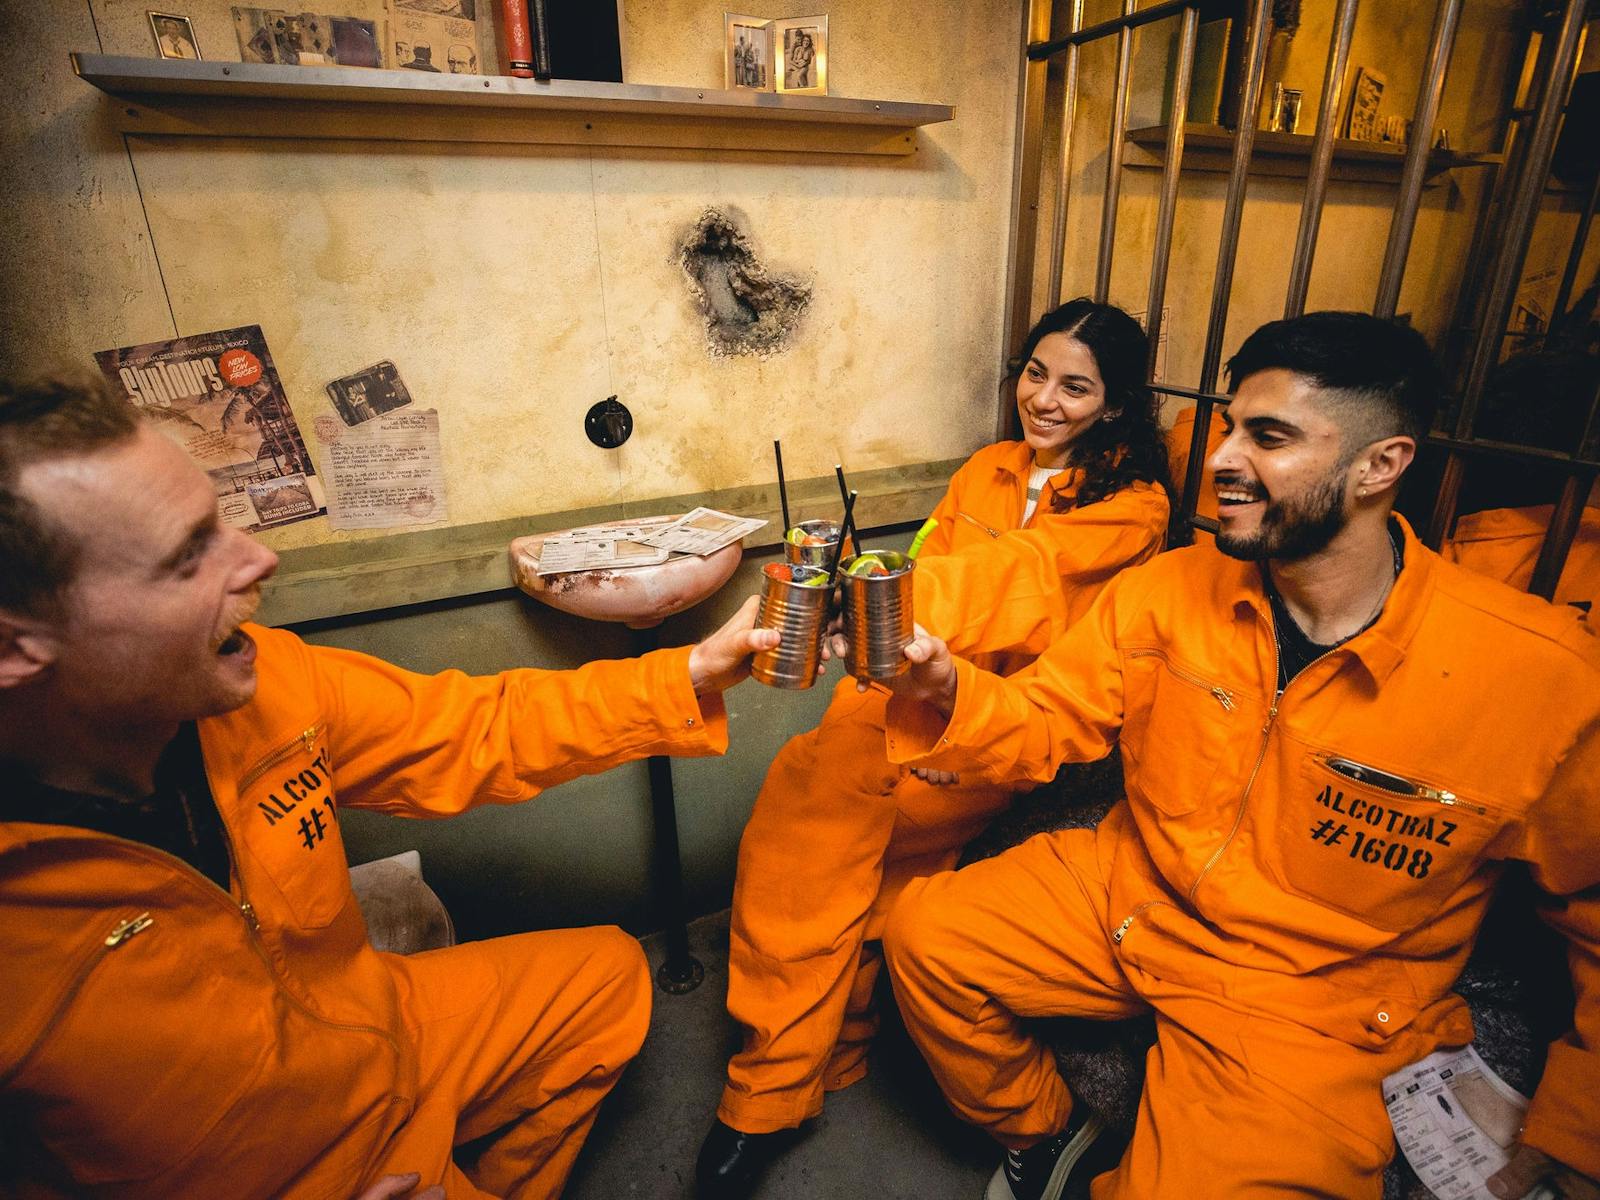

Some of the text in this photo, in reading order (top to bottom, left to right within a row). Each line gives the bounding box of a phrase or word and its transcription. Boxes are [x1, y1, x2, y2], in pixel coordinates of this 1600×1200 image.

[227, 354, 247, 368] NEW
[229, 365, 259, 381] PRICES
[232, 361, 249, 373] LOW
[119, 357, 224, 408] SkyTours
[1316, 785, 1457, 847] ALCOTRAZ
[1310, 818, 1433, 879] #1608
